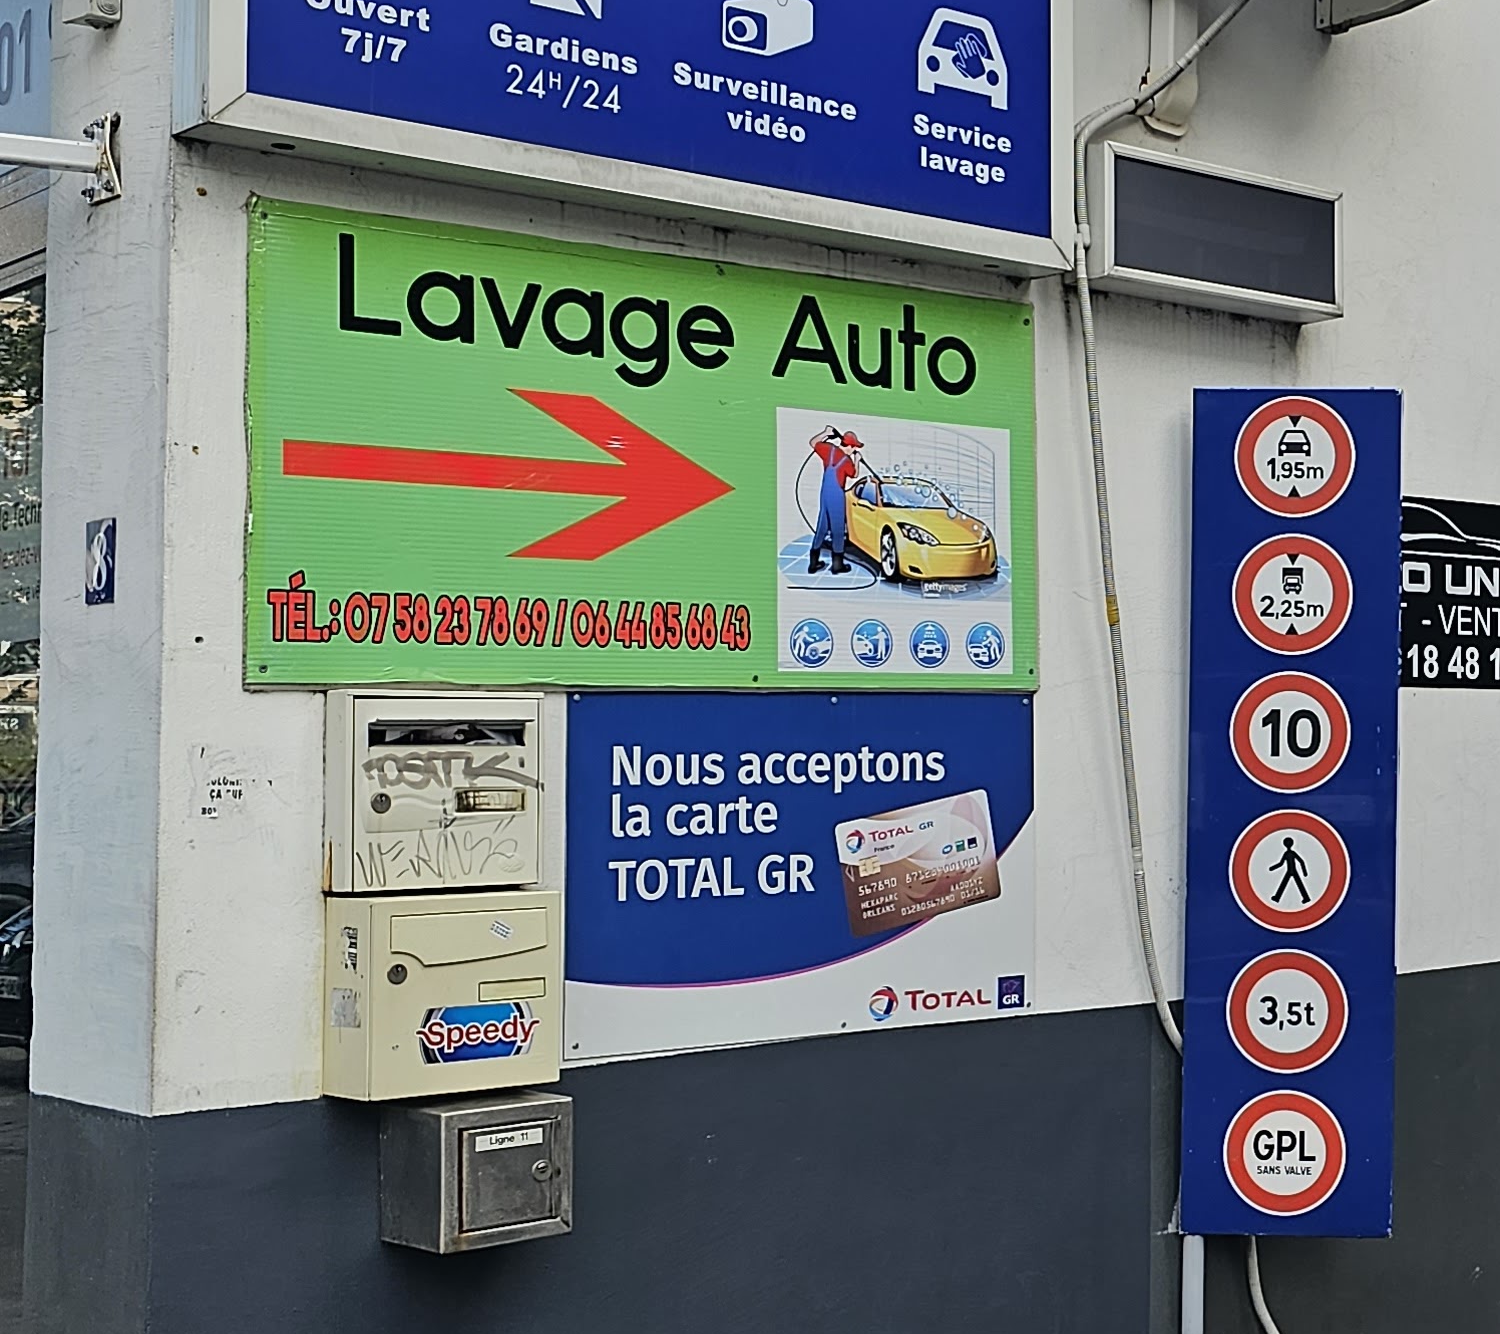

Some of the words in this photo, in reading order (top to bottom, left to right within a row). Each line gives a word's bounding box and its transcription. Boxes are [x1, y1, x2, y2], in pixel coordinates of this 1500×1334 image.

[340, 27, 407, 63] 7j/7
[489, 22, 638, 74] Gardiens
[673, 62, 857, 121] Surveillance
[727, 111, 806, 143] vidéo
[913, 114, 1012, 153] Service
[920, 145, 1006, 185] lavage
[338, 233, 736, 388] Lavage
[771, 294, 978, 396] Auto
[1267, 457, 1324, 482] 1,95m
[344, 591, 390, 644] 07
[393, 593, 431, 645] 58
[434, 595, 472, 646] 23
[474, 596, 511, 647] 78
[513, 597, 550, 648] 69
[571, 599, 612, 649] 06
[614, 600, 647, 649] 44
[649, 602, 682, 650] 85
[684, 603, 717, 651] 68
[719, 604, 752, 652] 43
[1259, 595, 1324, 620] 2,25m
[1407, 643, 1439, 679] 18
[1447, 645, 1480, 680] 48
[1261, 709, 1321, 758] 10
[612, 745, 725, 786] Nous
[737, 746, 945, 794] acceptons
[612, 793, 651, 838] la
[666, 796, 778, 836] carte
[868, 825, 914, 842] TOTAL
[918, 821, 934, 831] GR
[609, 857, 744, 902] TOTAL
[757, 854, 815, 893] GR
[904, 989, 992, 1011] TOTAL
[1002, 994, 1020, 1005] GR
[1258, 995, 1315, 1031] 3,5t
[416, 1014, 540, 1051] Speedy
[489, 1134, 515, 1147] Ligne
[1253, 1129, 1316, 1162] GPL
[1257, 1165, 1281, 1175] SANS
[1284, 1165, 1312, 1175] VALVE
